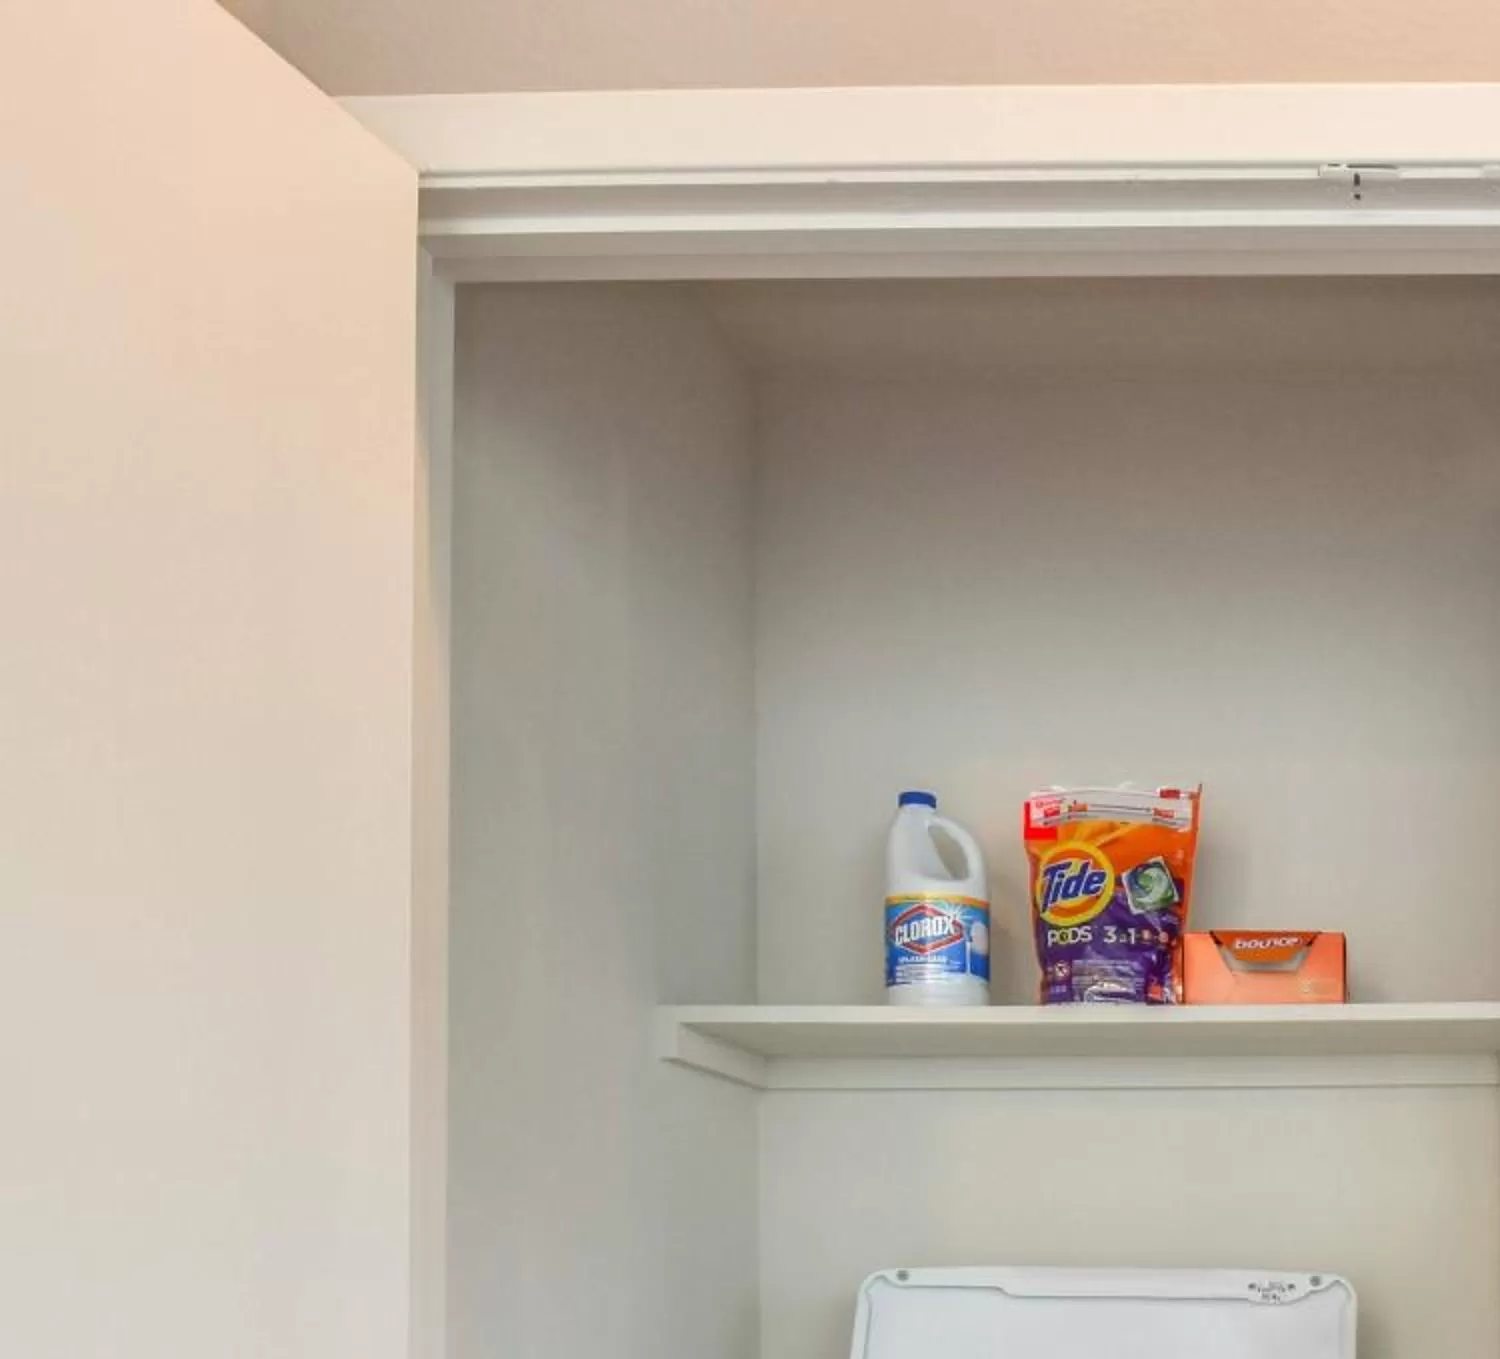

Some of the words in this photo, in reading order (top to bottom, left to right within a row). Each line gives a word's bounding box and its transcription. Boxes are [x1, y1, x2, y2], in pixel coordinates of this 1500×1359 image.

[1041, 857, 1108, 913] Tide
[895, 912, 957, 945] CLOROX
[1047, 925, 1093, 948] PODS
